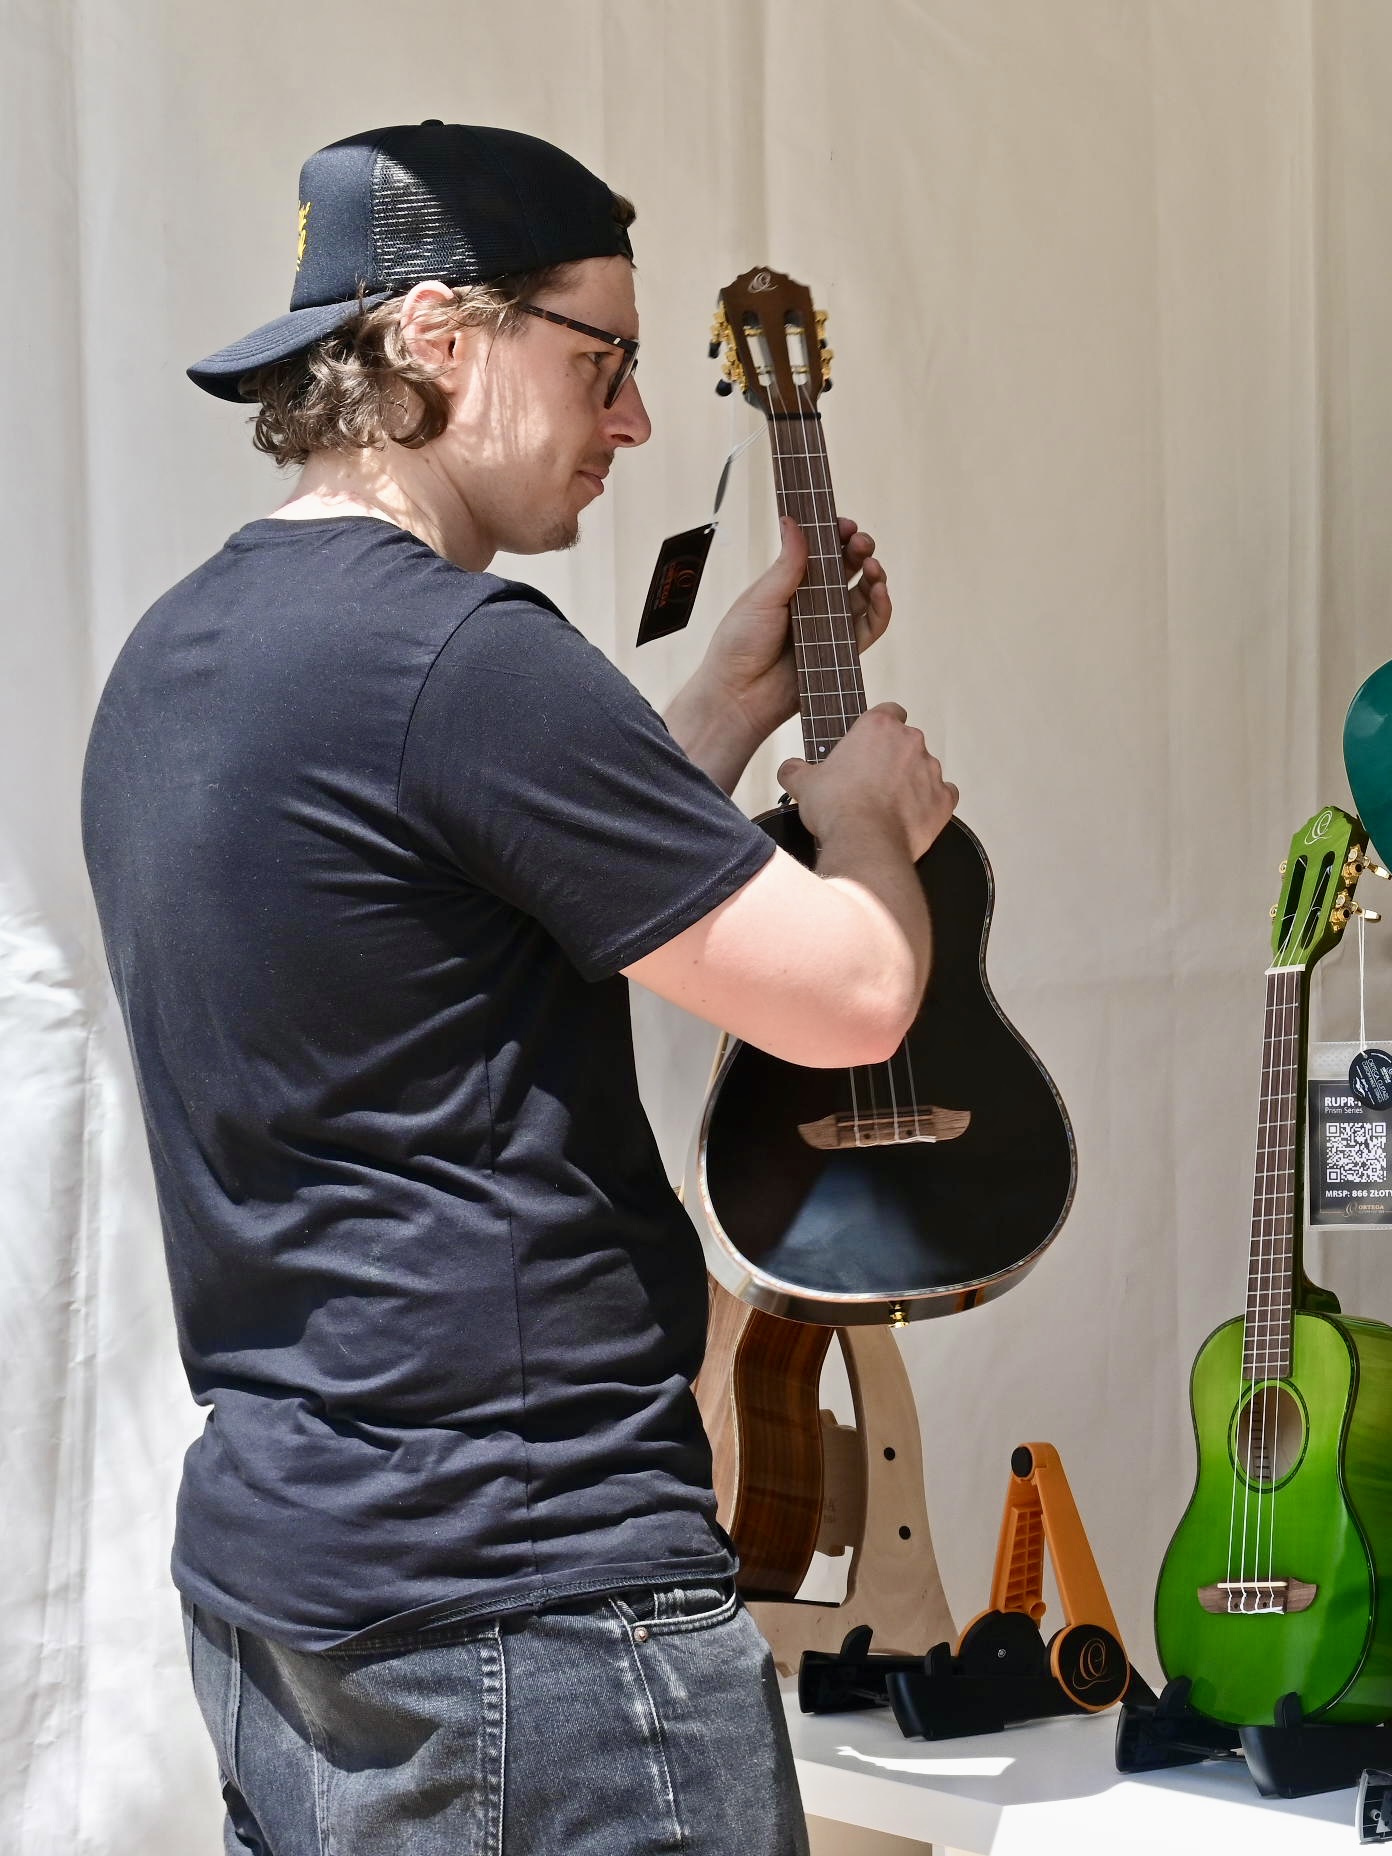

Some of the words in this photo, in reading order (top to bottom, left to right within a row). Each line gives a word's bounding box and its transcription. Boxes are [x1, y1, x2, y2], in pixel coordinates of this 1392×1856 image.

[1324, 1106, 1343, 1114] Prism
[1344, 1106, 1363, 1114] Series
[1325, 1190, 1351, 1198] MRSP:
[1351, 1189, 1368, 1198] 866
